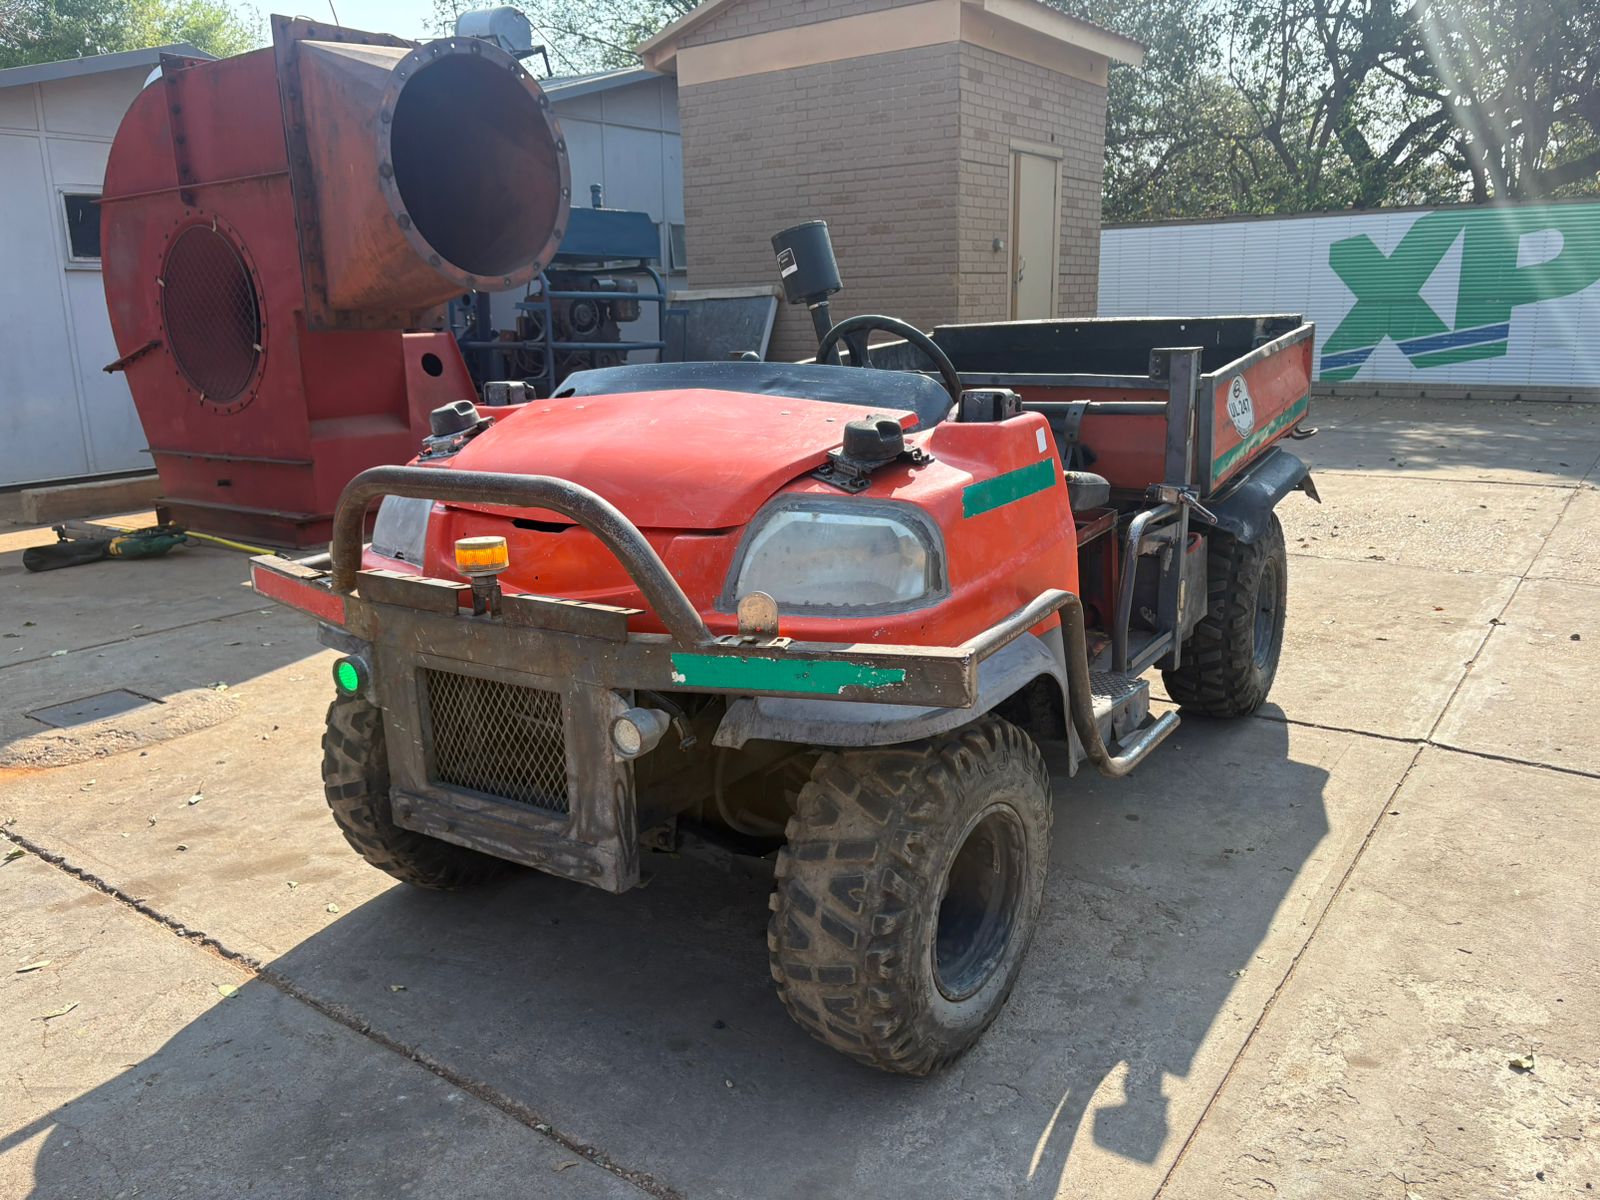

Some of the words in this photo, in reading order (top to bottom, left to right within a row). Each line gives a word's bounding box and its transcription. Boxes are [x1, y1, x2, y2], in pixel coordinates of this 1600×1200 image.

[1319, 204, 1600, 382] XP
[1229, 402, 1240, 417] UL
[1238, 398, 1250, 414] 247
